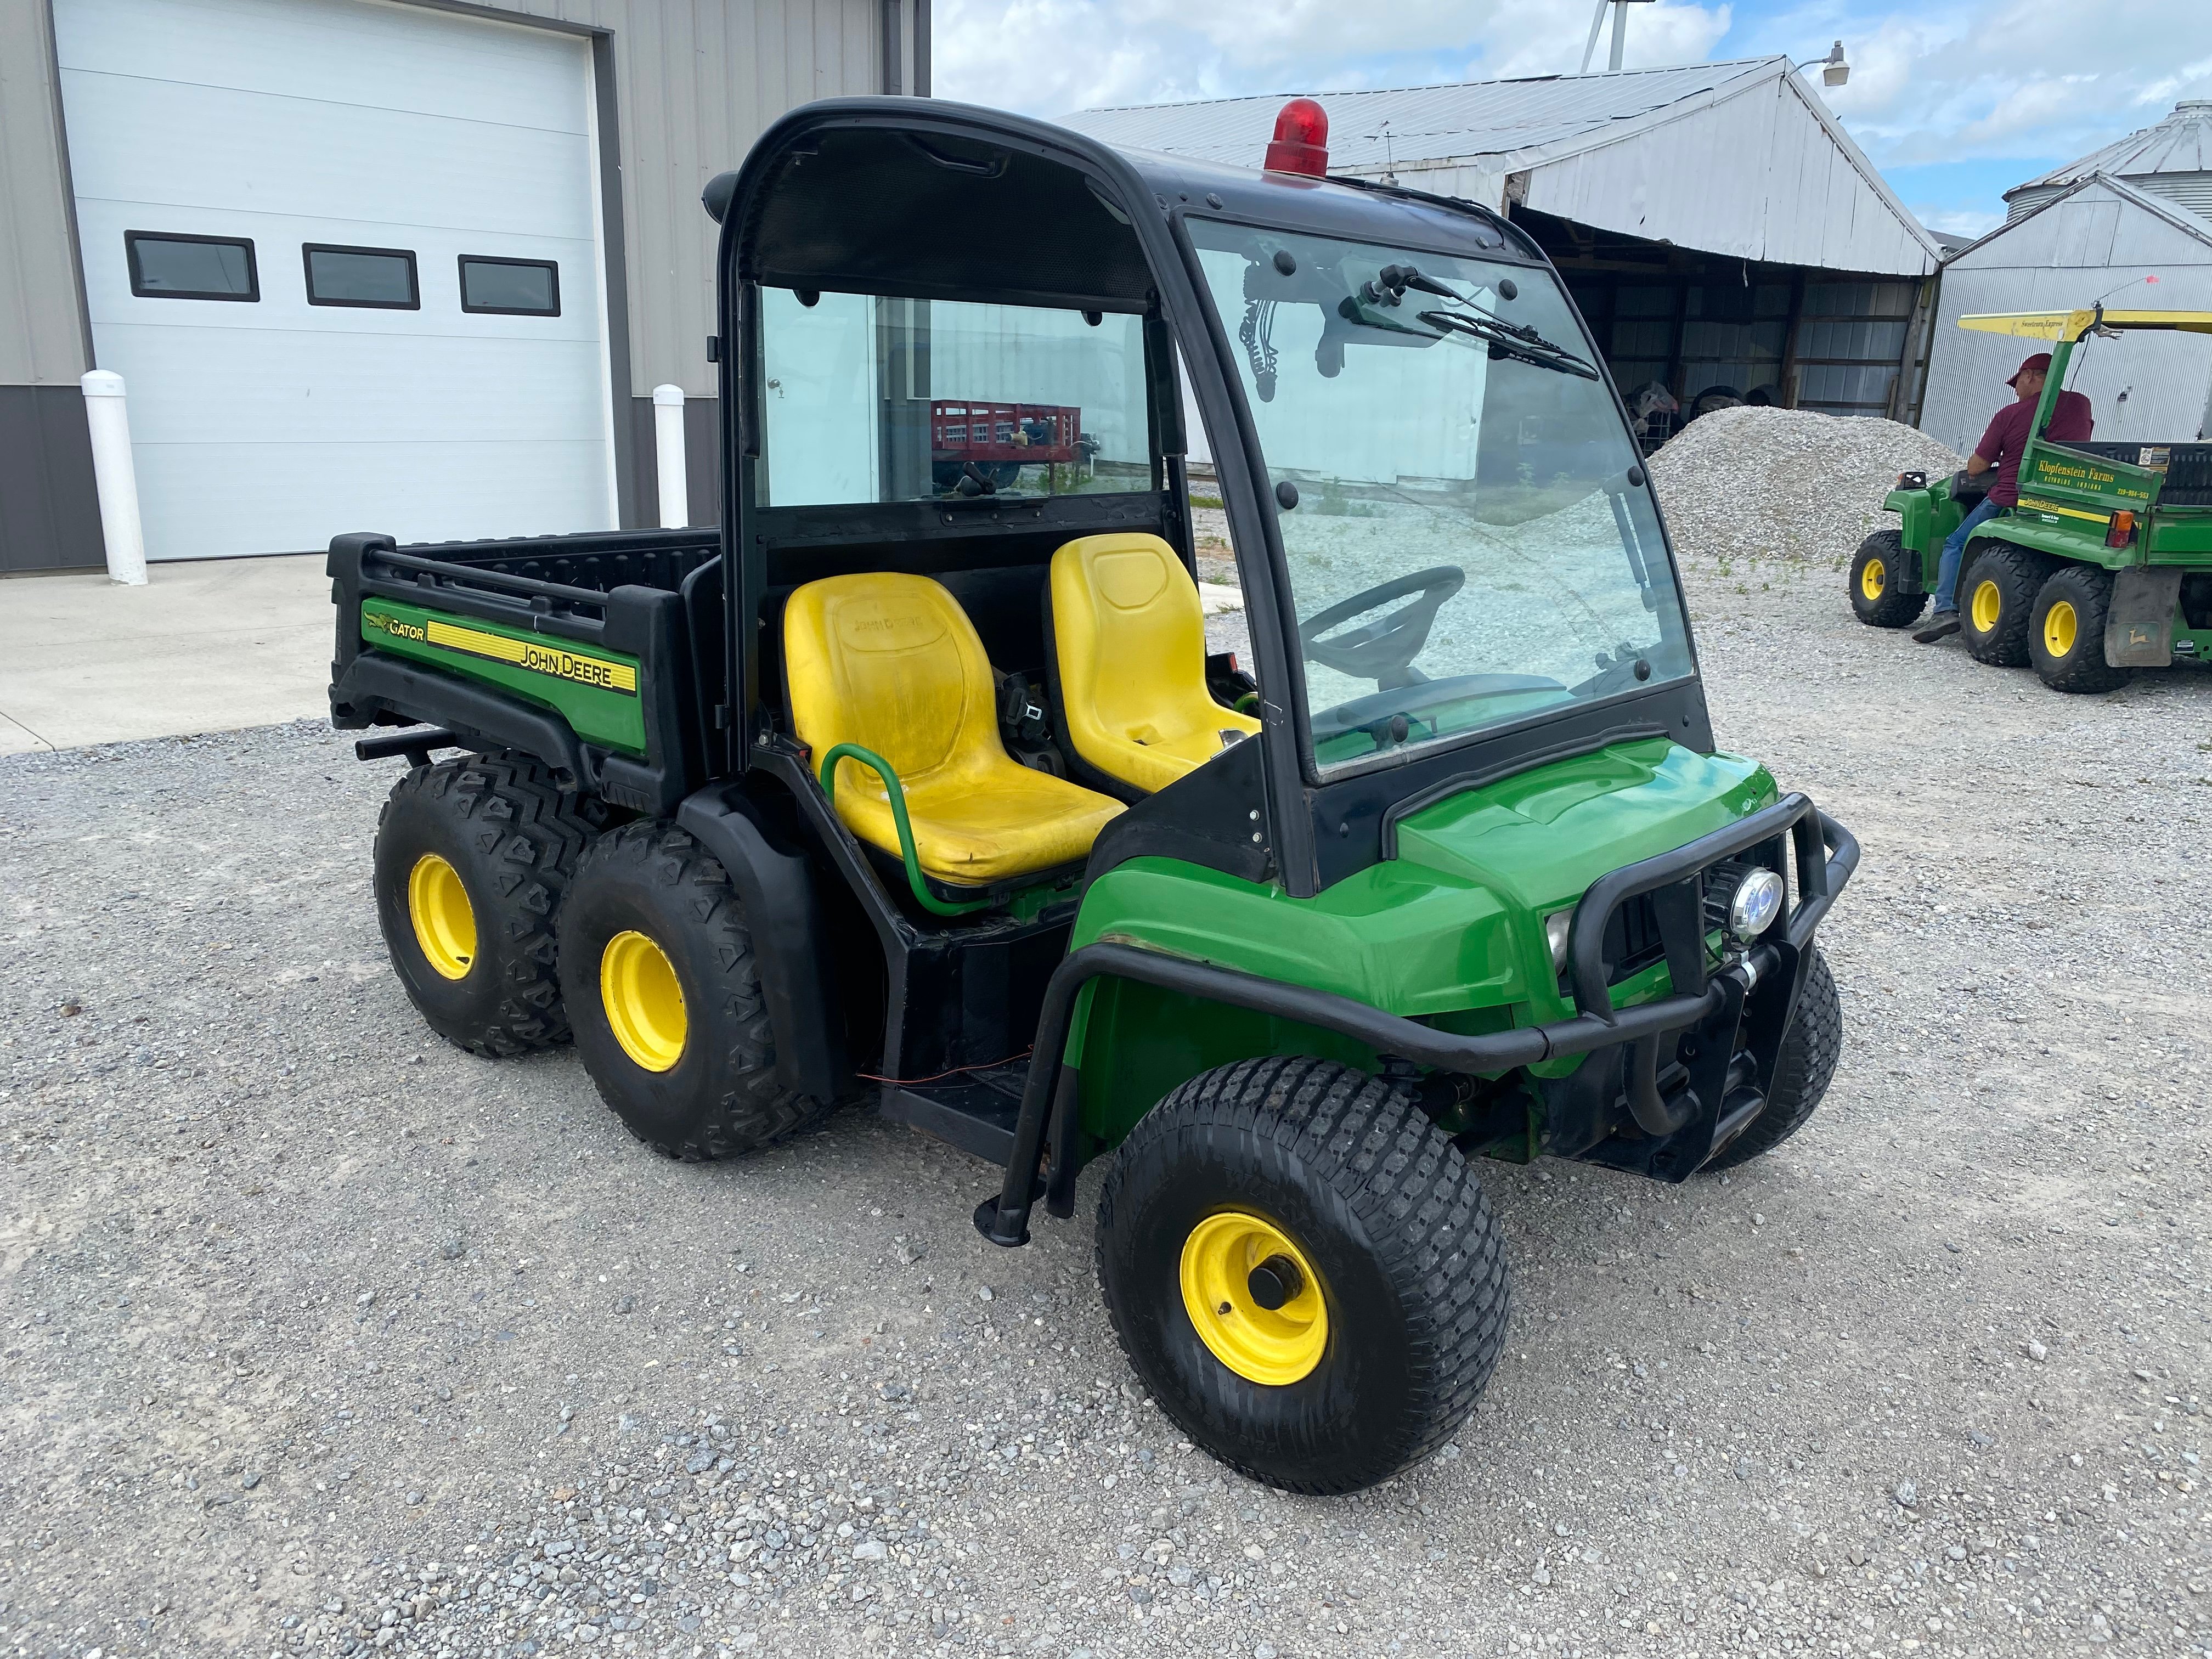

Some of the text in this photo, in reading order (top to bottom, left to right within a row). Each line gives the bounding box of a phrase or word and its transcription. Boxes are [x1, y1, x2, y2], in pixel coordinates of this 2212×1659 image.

[2044, 320, 2063, 328] Express
[2038, 460, 2115, 483] Klopfenstein Farms
[2077, 481, 2102, 491] INDIANA
[2024, 498, 2059, 512] JOHN DEERE
[389, 619, 424, 641] GATOR
[520, 645, 612, 685] JOHN DEERE
